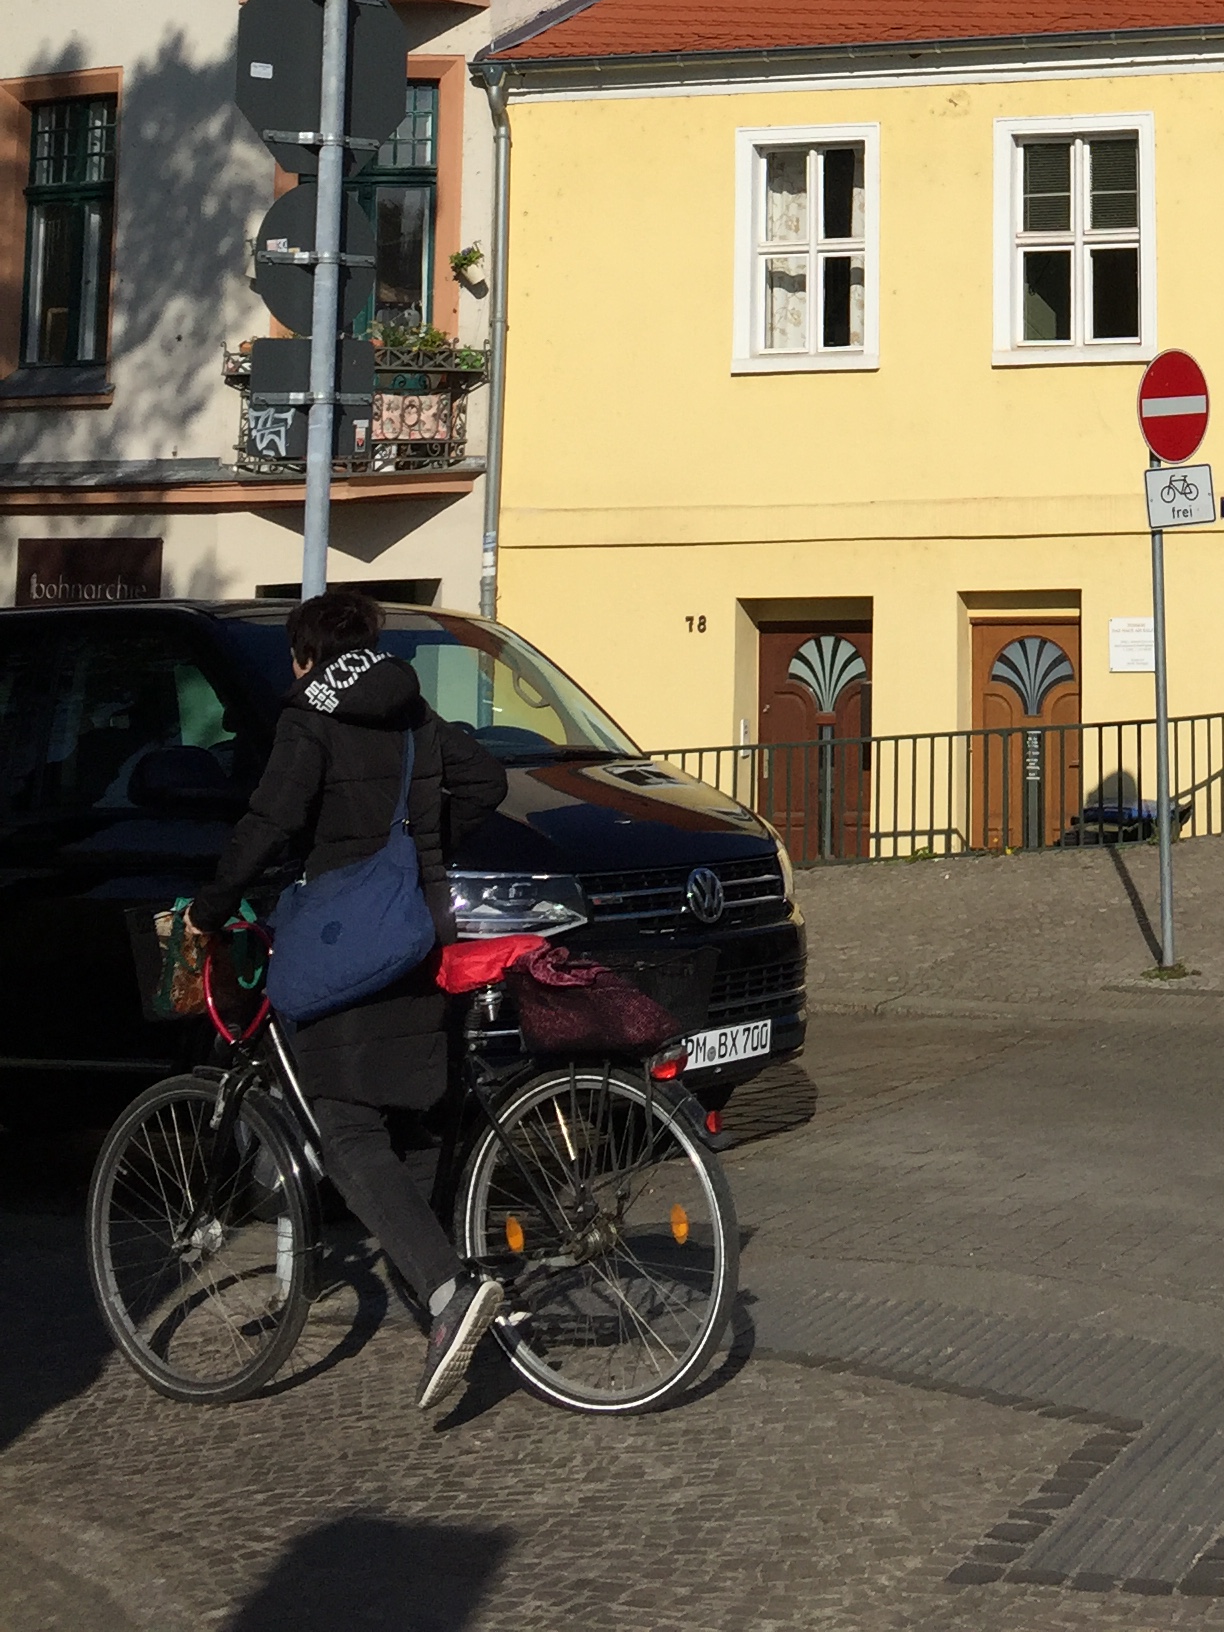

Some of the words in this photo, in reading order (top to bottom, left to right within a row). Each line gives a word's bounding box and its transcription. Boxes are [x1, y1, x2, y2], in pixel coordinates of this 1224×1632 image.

[1171, 504, 1193, 519] frei
[685, 614, 707, 634] 78
[685, 1035, 707, 1064] PM
[718, 1029, 740, 1059] BX
[742, 1023, 769, 1054] 700
